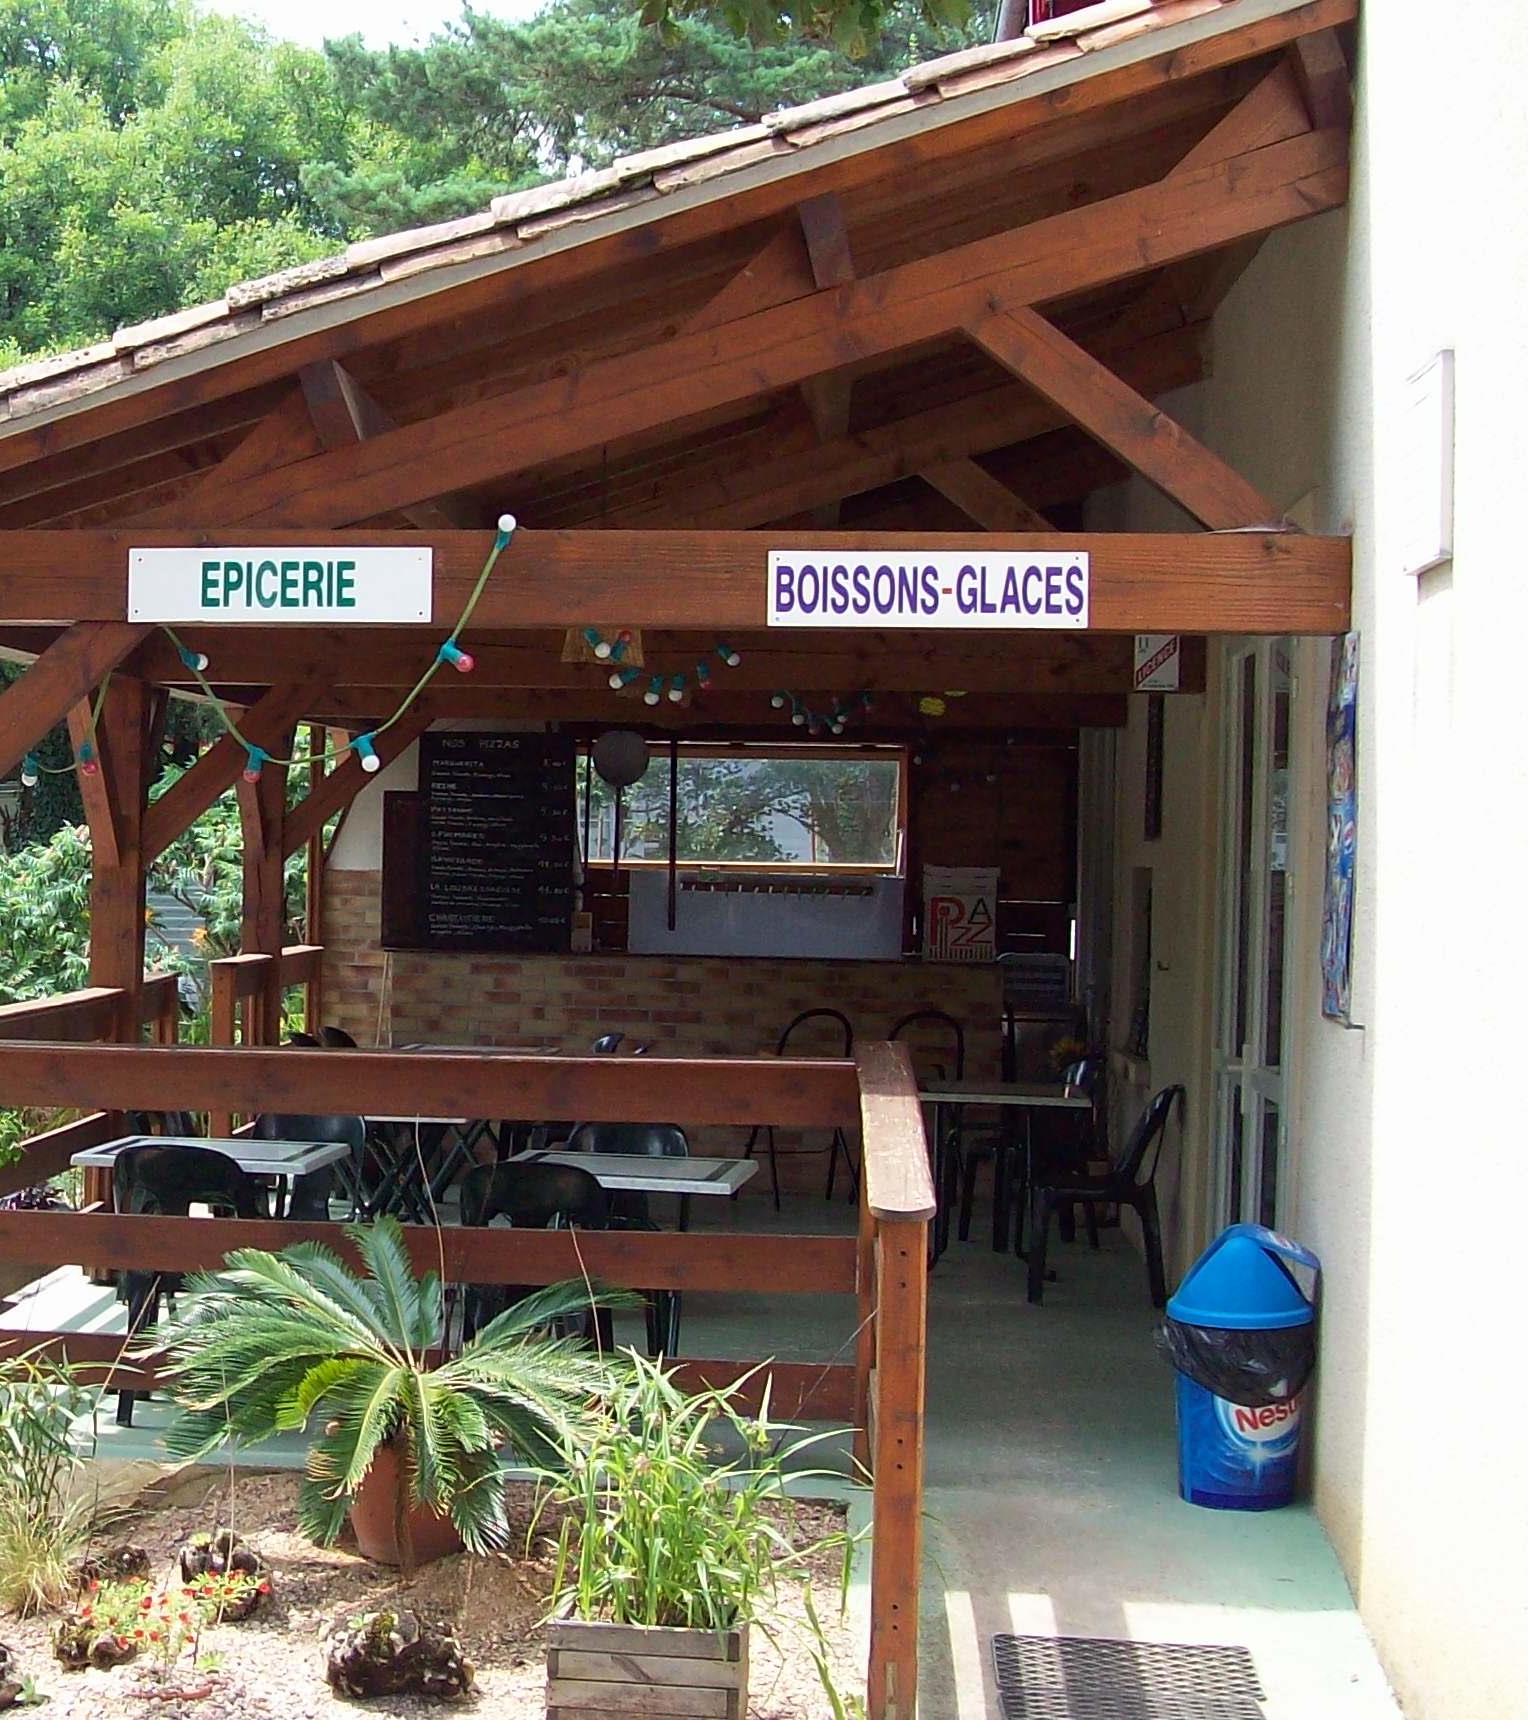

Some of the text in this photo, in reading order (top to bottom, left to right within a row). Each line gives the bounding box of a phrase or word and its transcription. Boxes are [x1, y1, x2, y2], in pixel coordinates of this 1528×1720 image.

[201, 560, 356, 608] EPICERIE
[775, 564, 1084, 616] BOISSONS-GLACES
[1235, 1397, 1299, 1432] Nest
